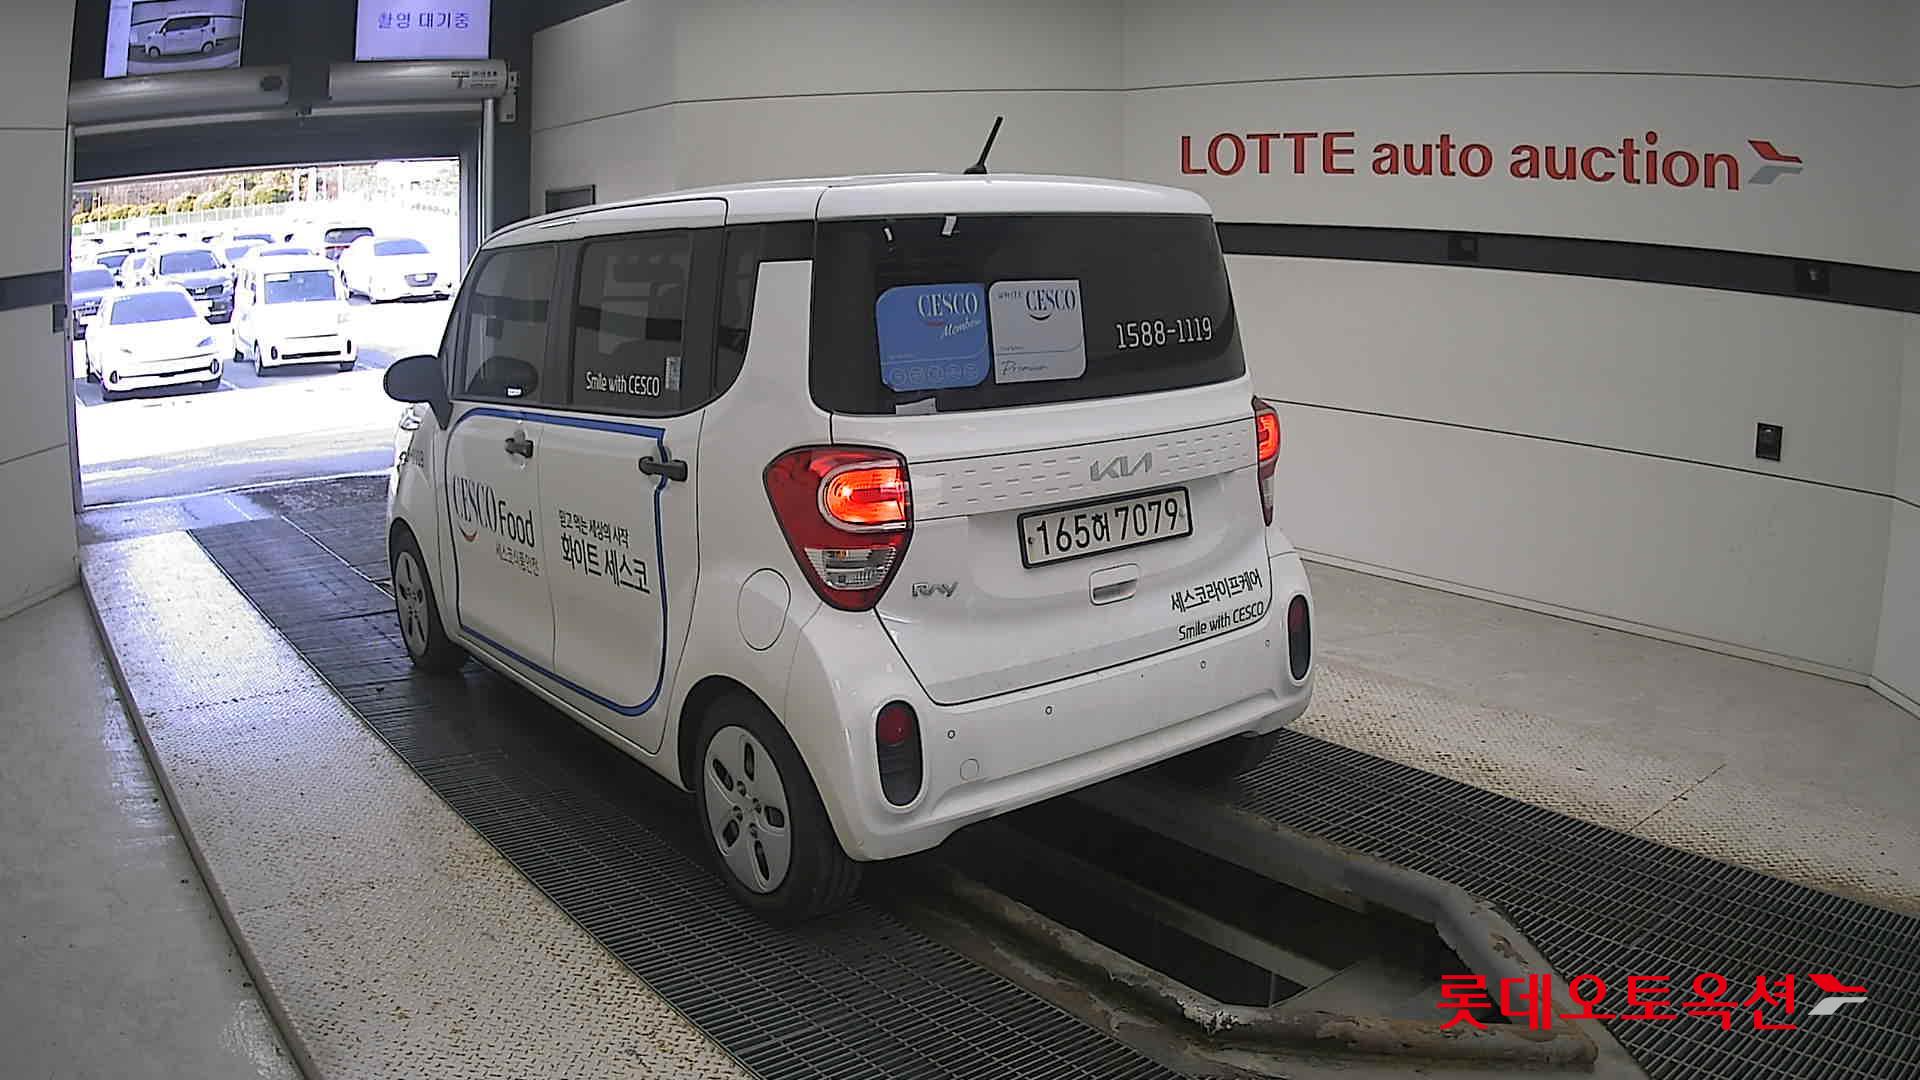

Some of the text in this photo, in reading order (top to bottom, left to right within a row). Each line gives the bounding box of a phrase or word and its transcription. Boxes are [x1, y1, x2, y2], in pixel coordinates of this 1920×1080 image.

[419, 12, 470, 29] 대기중
[1180, 130, 1740, 191] LOTTE auto auction
[917, 291, 979, 318] CESCO
[1025, 289, 1077, 311] CESCO
[1115, 317, 1213, 349] 1588-1119
[585, 371, 660, 397] Smile with CESCO
[453, 474, 535, 548] CESCO Food
[1035, 498, 1179, 556] 165허 7079
[613, 525, 629, 549] 시작
[561, 532, 650, 594] 화이트 세스코
[1171, 568, 1263, 613] 세스코라이프케어
[1178, 600, 1264, 641] Smile with CESCO
